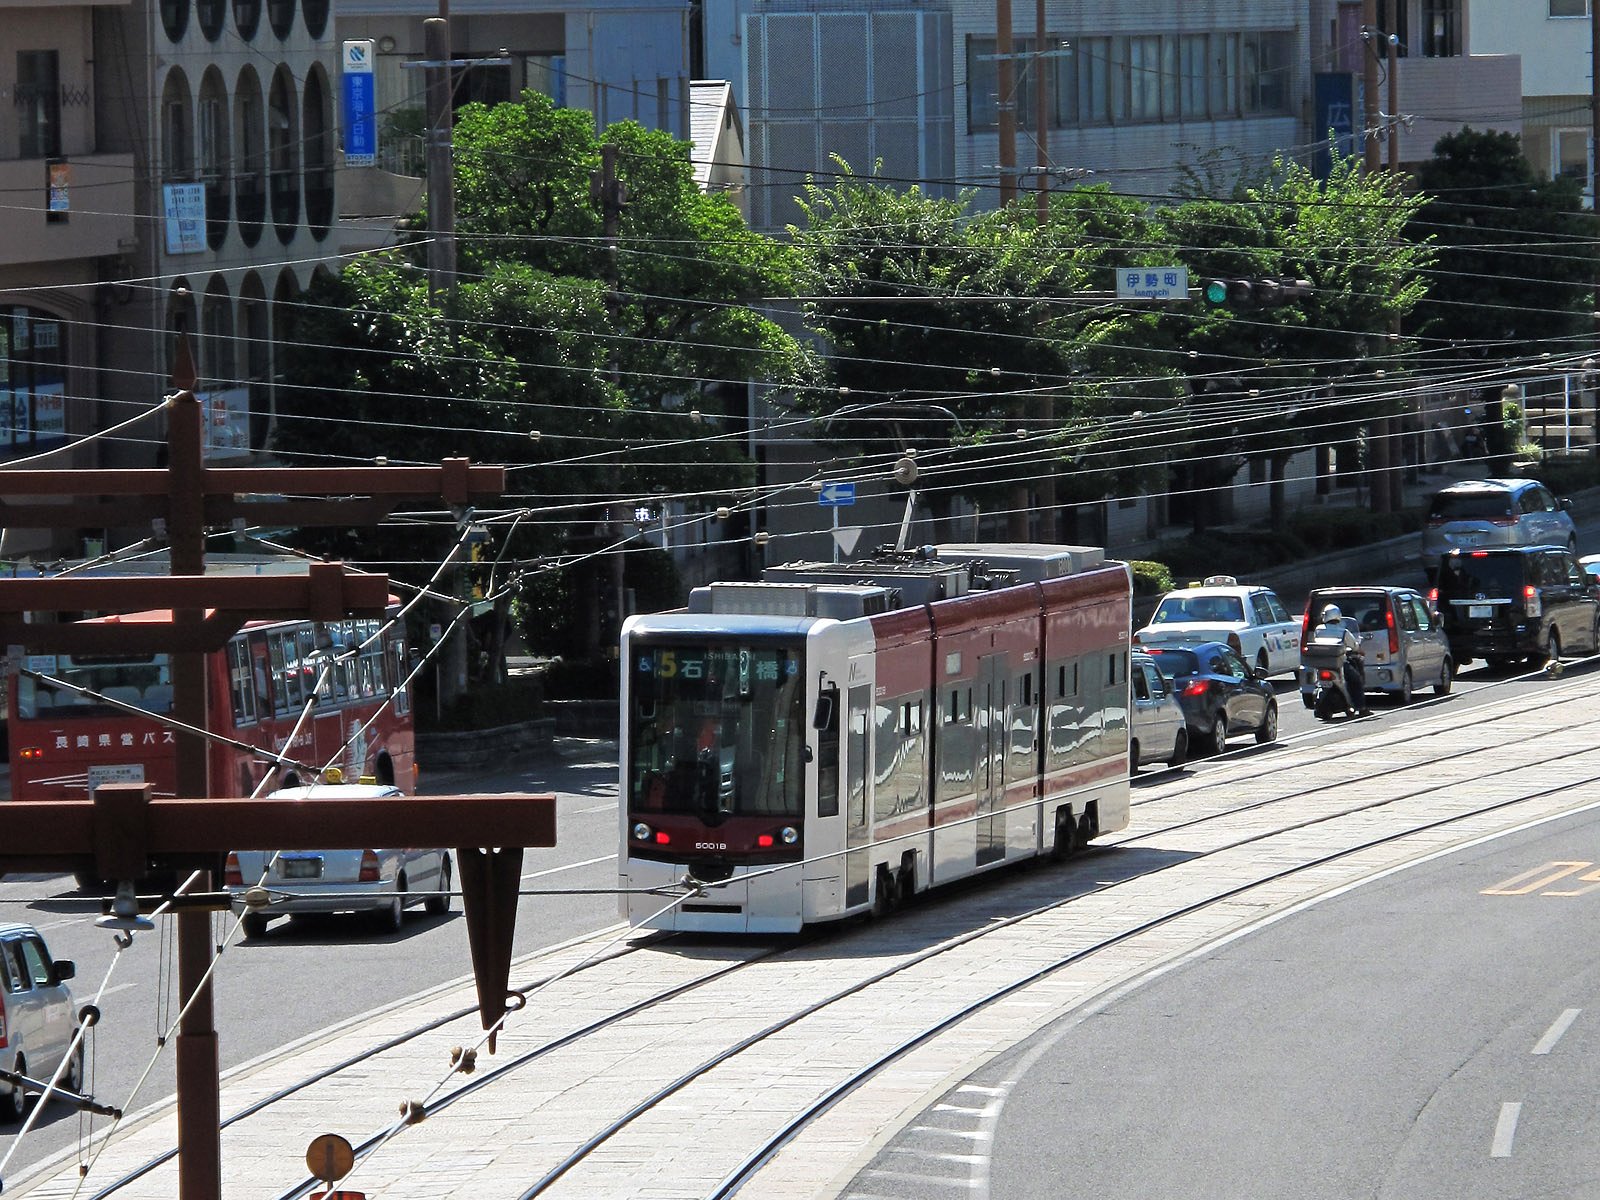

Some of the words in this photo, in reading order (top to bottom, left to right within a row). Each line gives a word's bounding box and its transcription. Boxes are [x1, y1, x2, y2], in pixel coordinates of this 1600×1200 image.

[351, 76, 365, 147] 東京海上日動
[1126, 272, 1177, 288] 伊勢町
[1134, 288, 1170, 297] Isemachi
[660, 651, 678, 678] 5
[695, 842, 727, 850] 5001B
